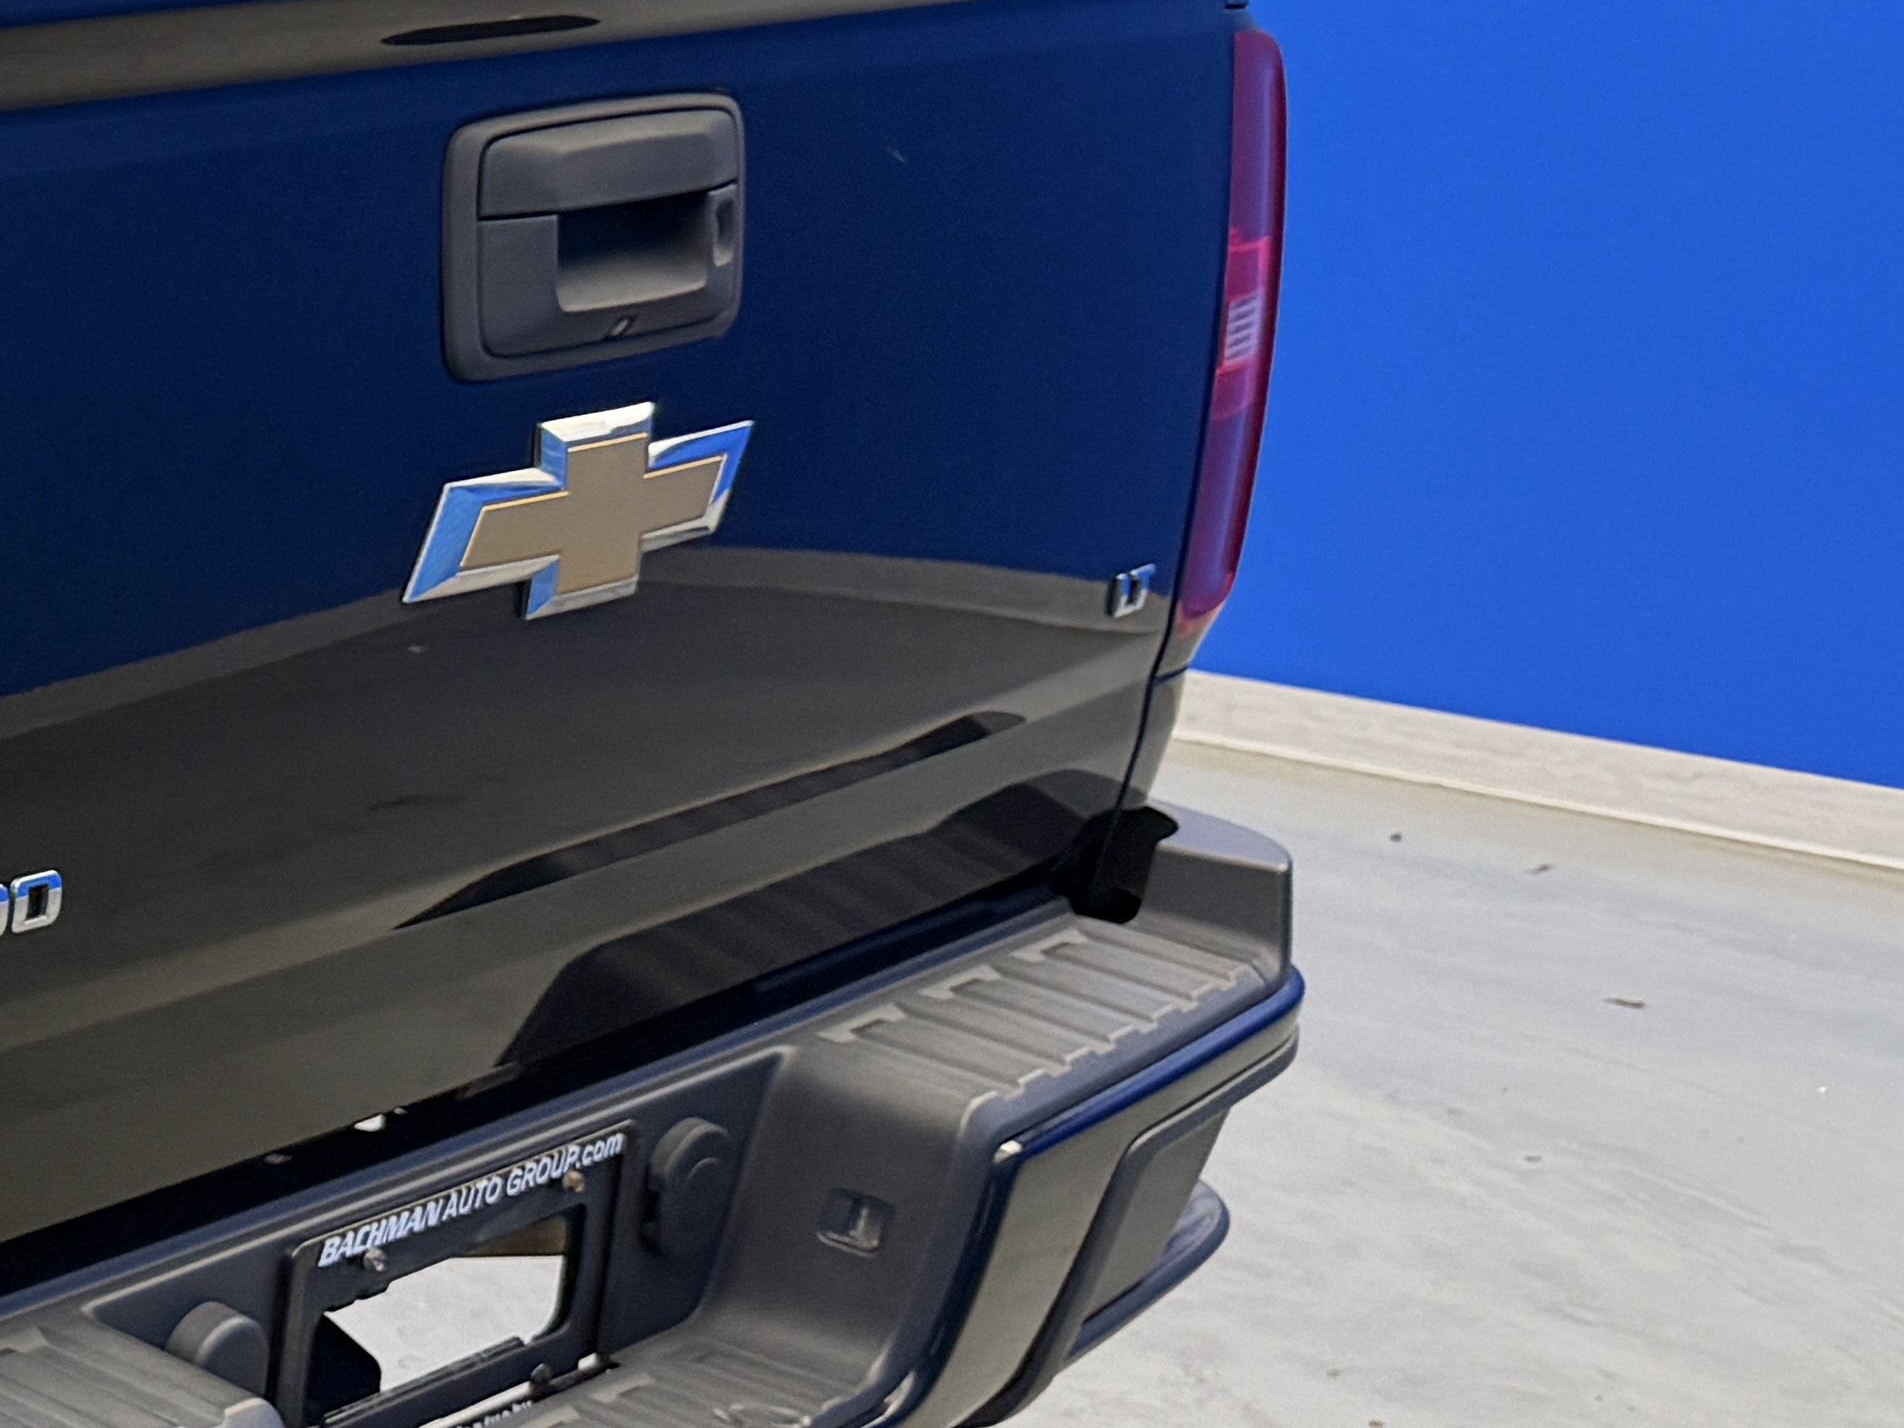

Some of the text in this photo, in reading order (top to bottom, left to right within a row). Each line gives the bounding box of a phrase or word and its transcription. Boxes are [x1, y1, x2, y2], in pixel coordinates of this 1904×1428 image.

[1108, 563, 1156, 618] LT
[317, 1131, 627, 1268] BACHMAN AUTO GROUP.com
